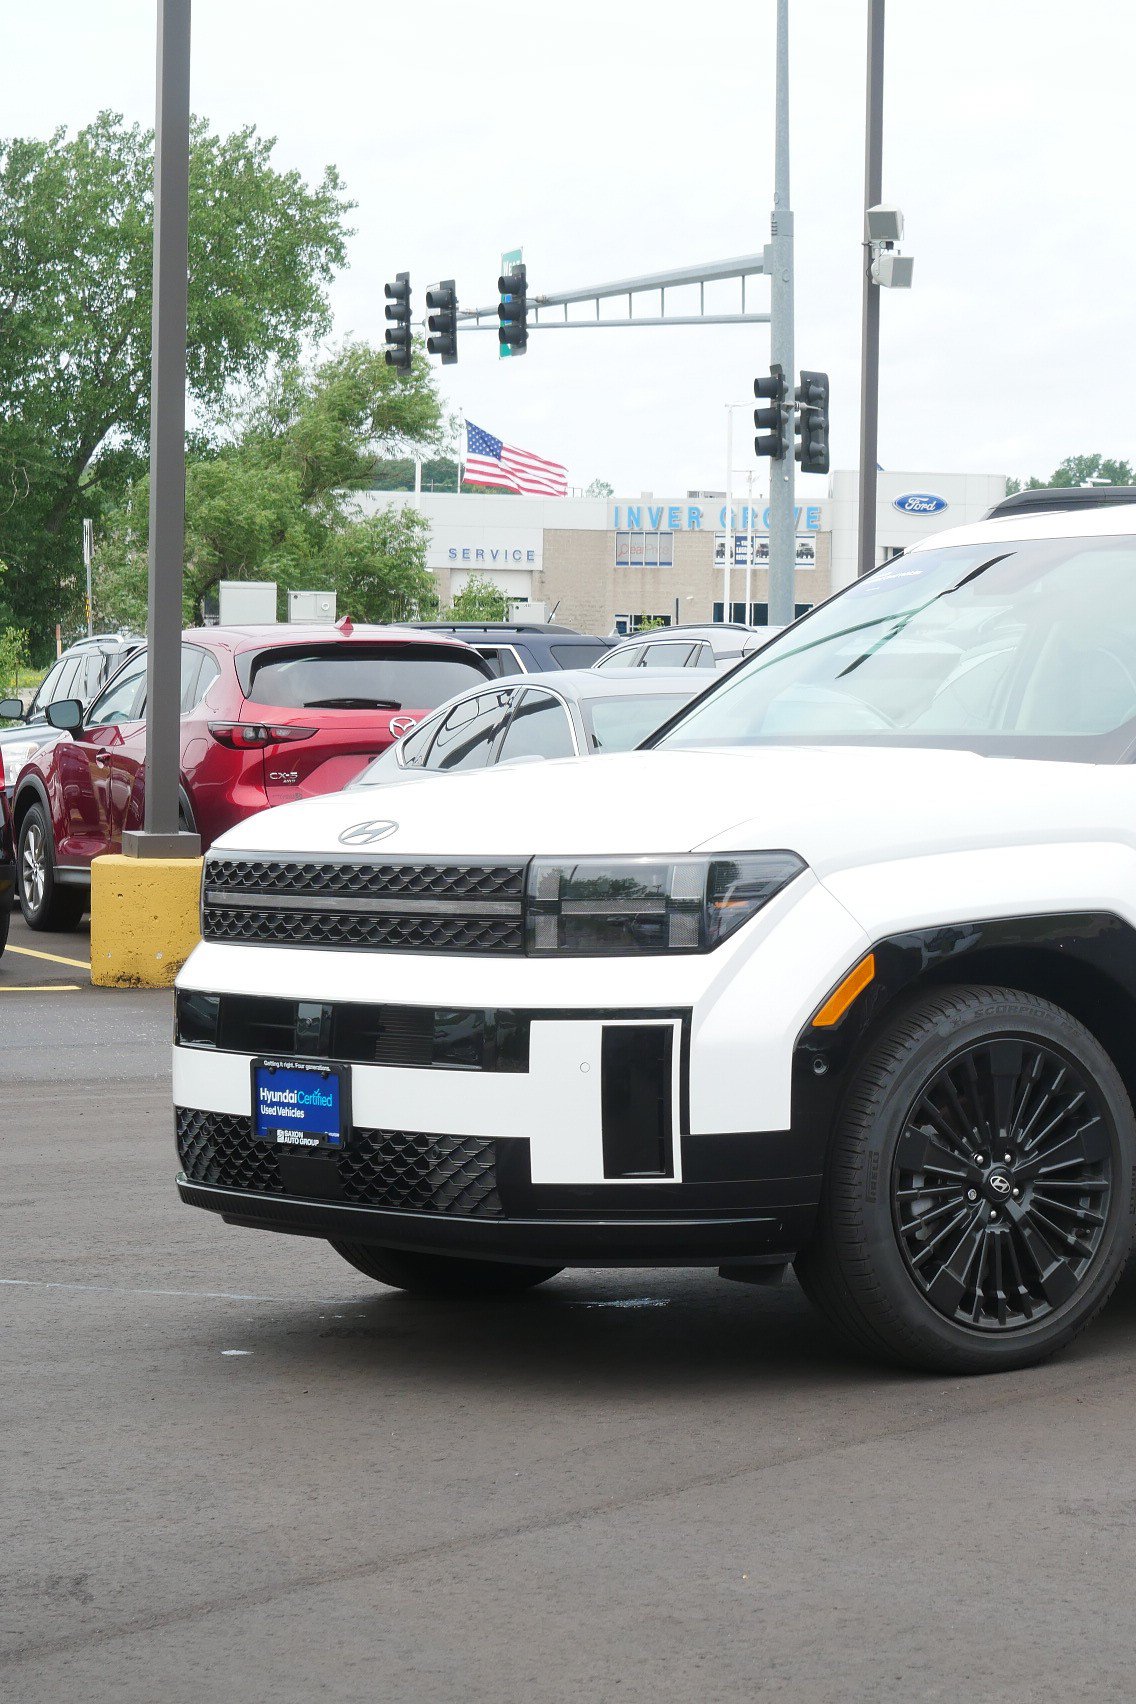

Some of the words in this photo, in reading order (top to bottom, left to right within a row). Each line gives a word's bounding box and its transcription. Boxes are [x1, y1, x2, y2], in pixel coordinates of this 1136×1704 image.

[905, 496, 937, 511] Ford
[613, 506, 702, 529] INVER
[448, 548, 535, 561] SERVICE
[270, 772, 298, 780] CX-5
[263, 1060, 279, 1069] Getting
[261, 1105, 277, 1116] Used
[277, 1106, 305, 1118] Vehicles
[284, 1130, 304, 1139] SAXON
[299, 1138, 320, 1147] GROUP
